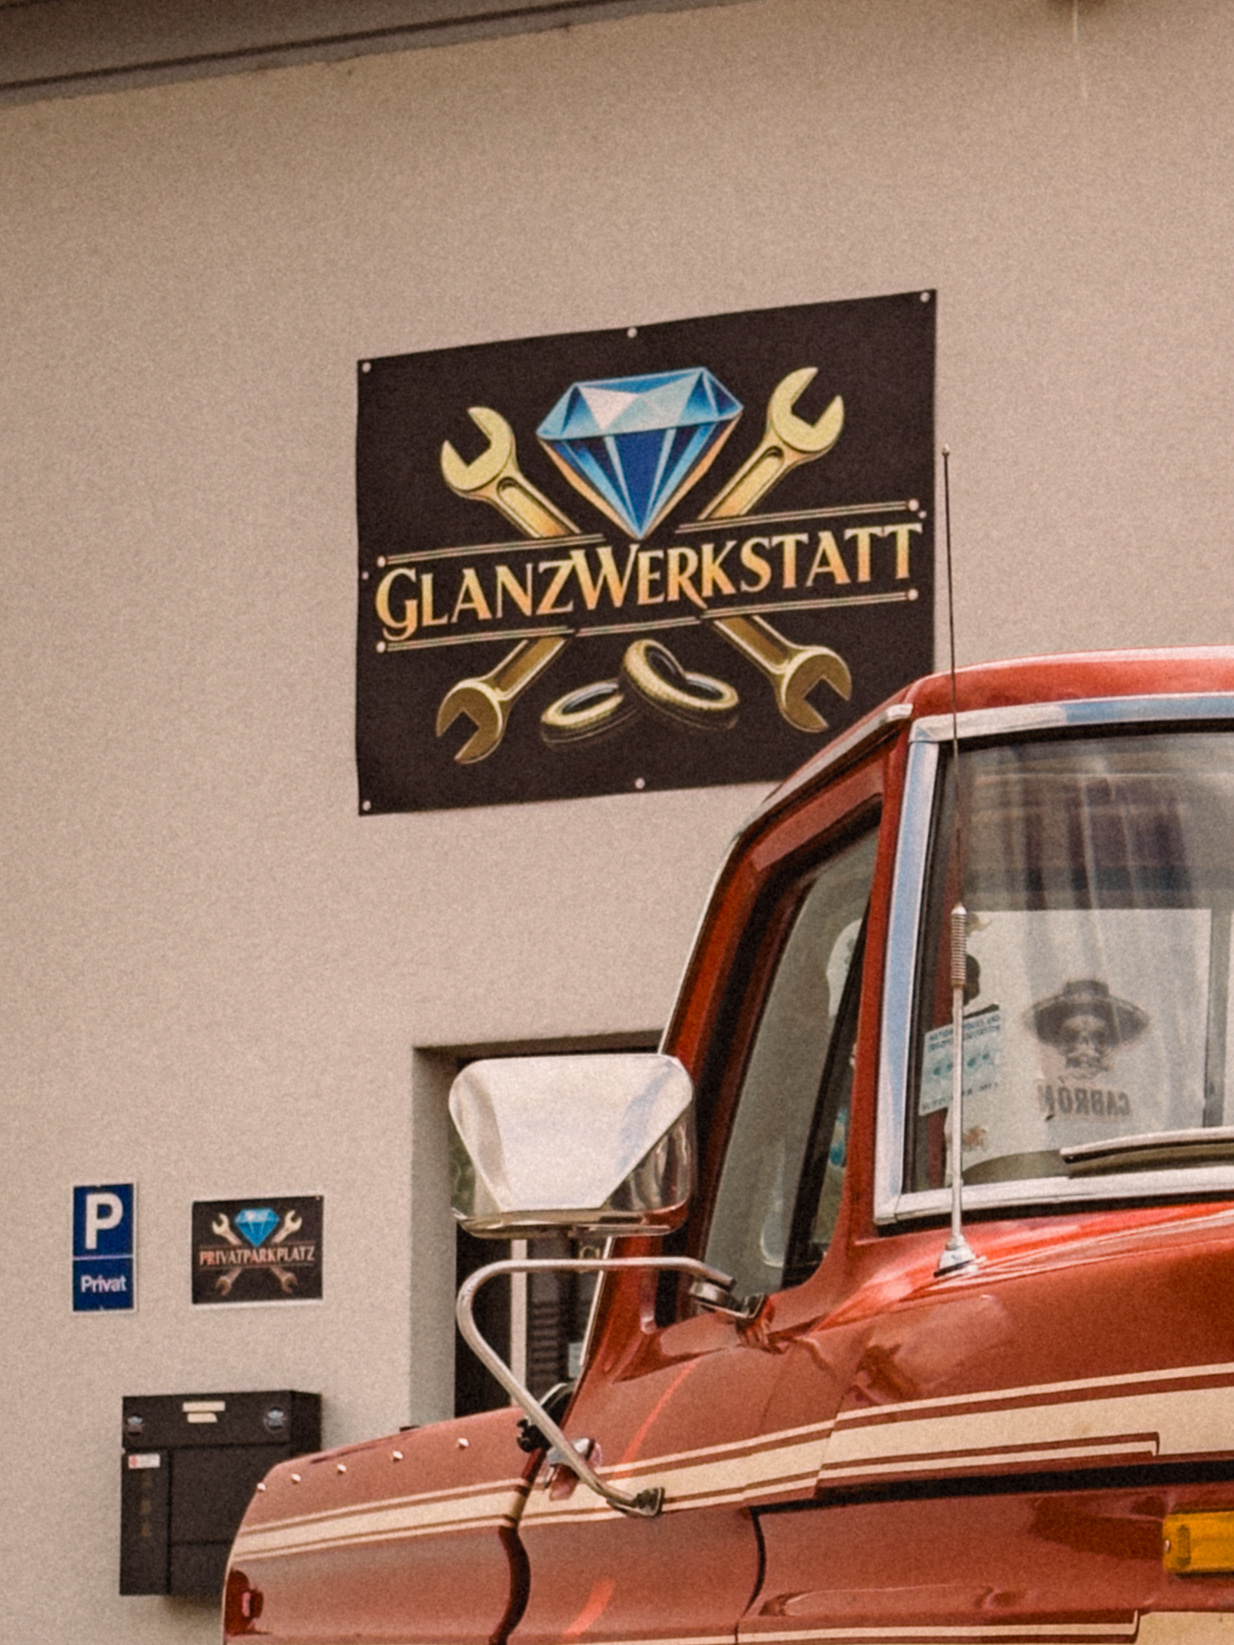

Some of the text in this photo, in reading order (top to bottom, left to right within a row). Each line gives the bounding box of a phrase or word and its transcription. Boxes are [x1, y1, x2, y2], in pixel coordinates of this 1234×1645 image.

[375, 522, 922, 641] GLANZWERKSTATT
[85, 1192, 124, 1250] P
[199, 1246, 316, 1266] PRIVATPARKPLATZ
[81, 1275, 127, 1293] Privat
